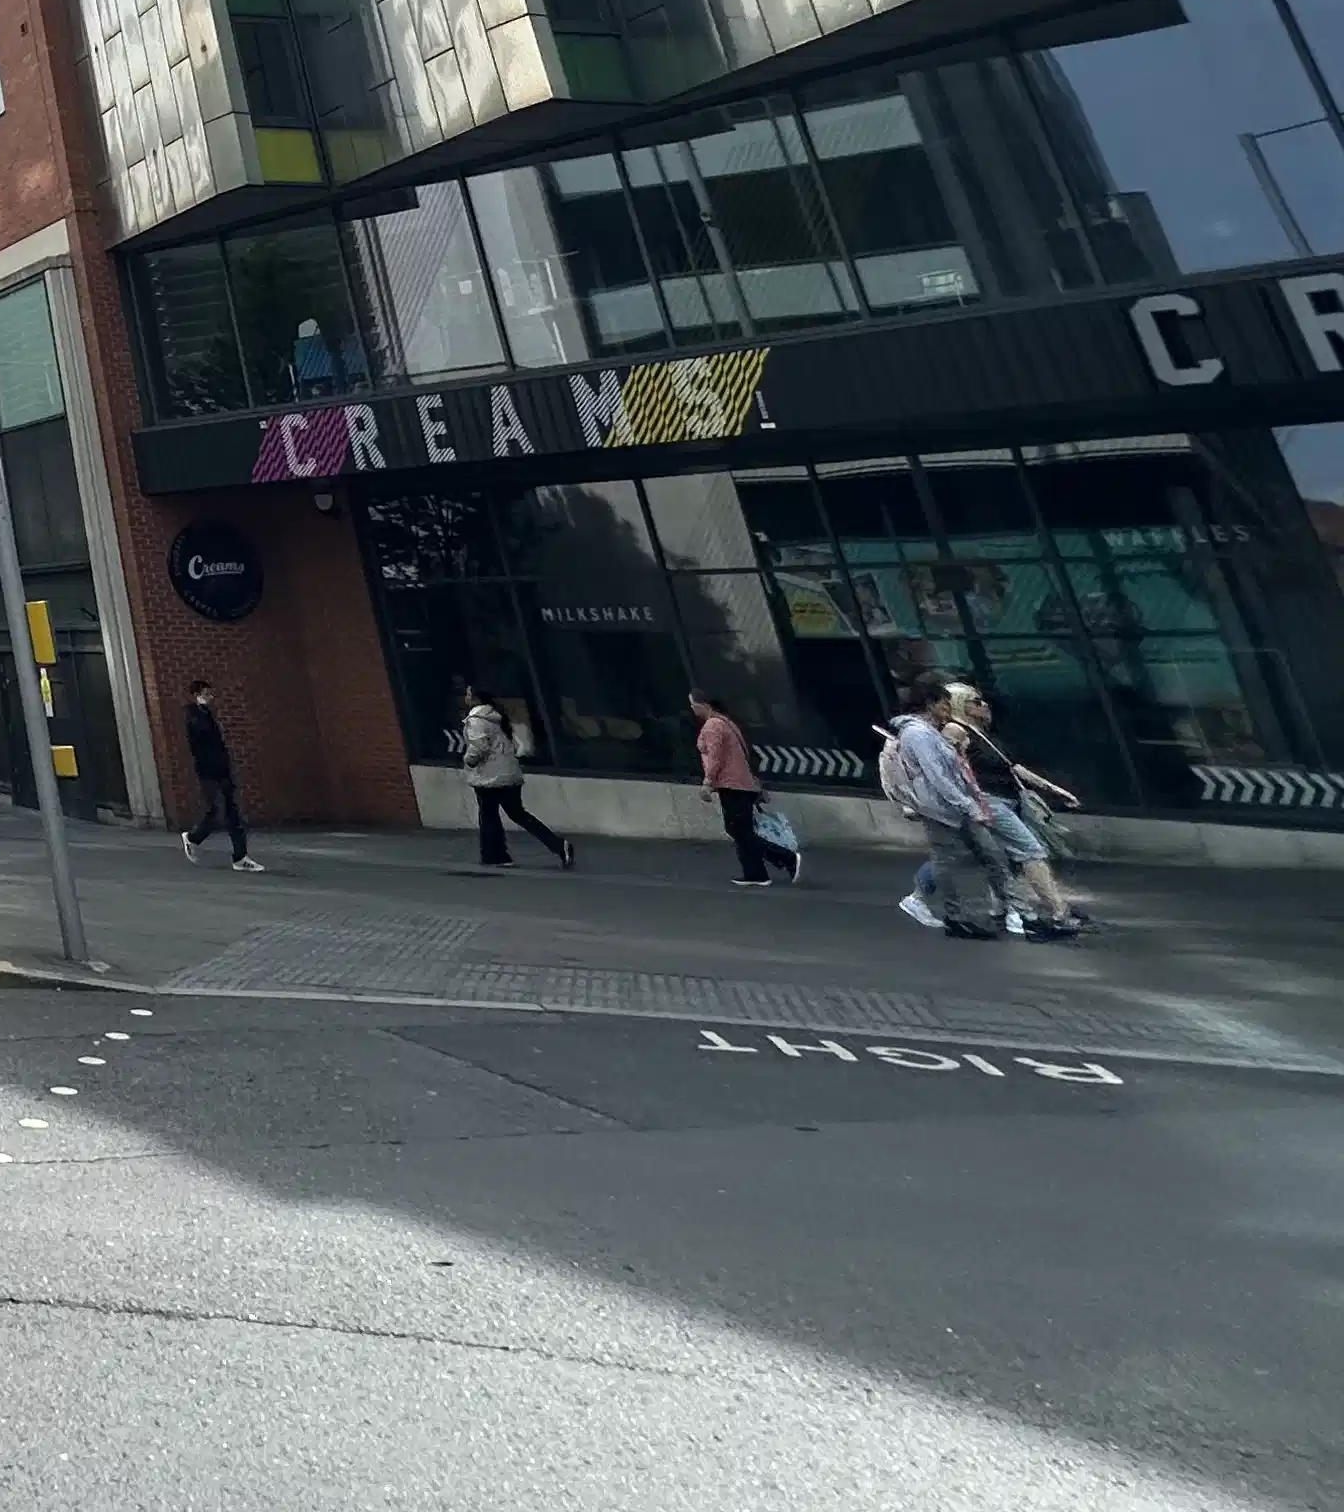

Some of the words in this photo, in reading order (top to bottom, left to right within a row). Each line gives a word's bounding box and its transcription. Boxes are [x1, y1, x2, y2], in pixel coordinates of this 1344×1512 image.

[1128, 272, 1344, 386] CR
[187, 554, 246, 580] Creams
[539, 606, 656, 623] MILKSHAKE
[698, 1031, 1124, 1085] RIGHT
